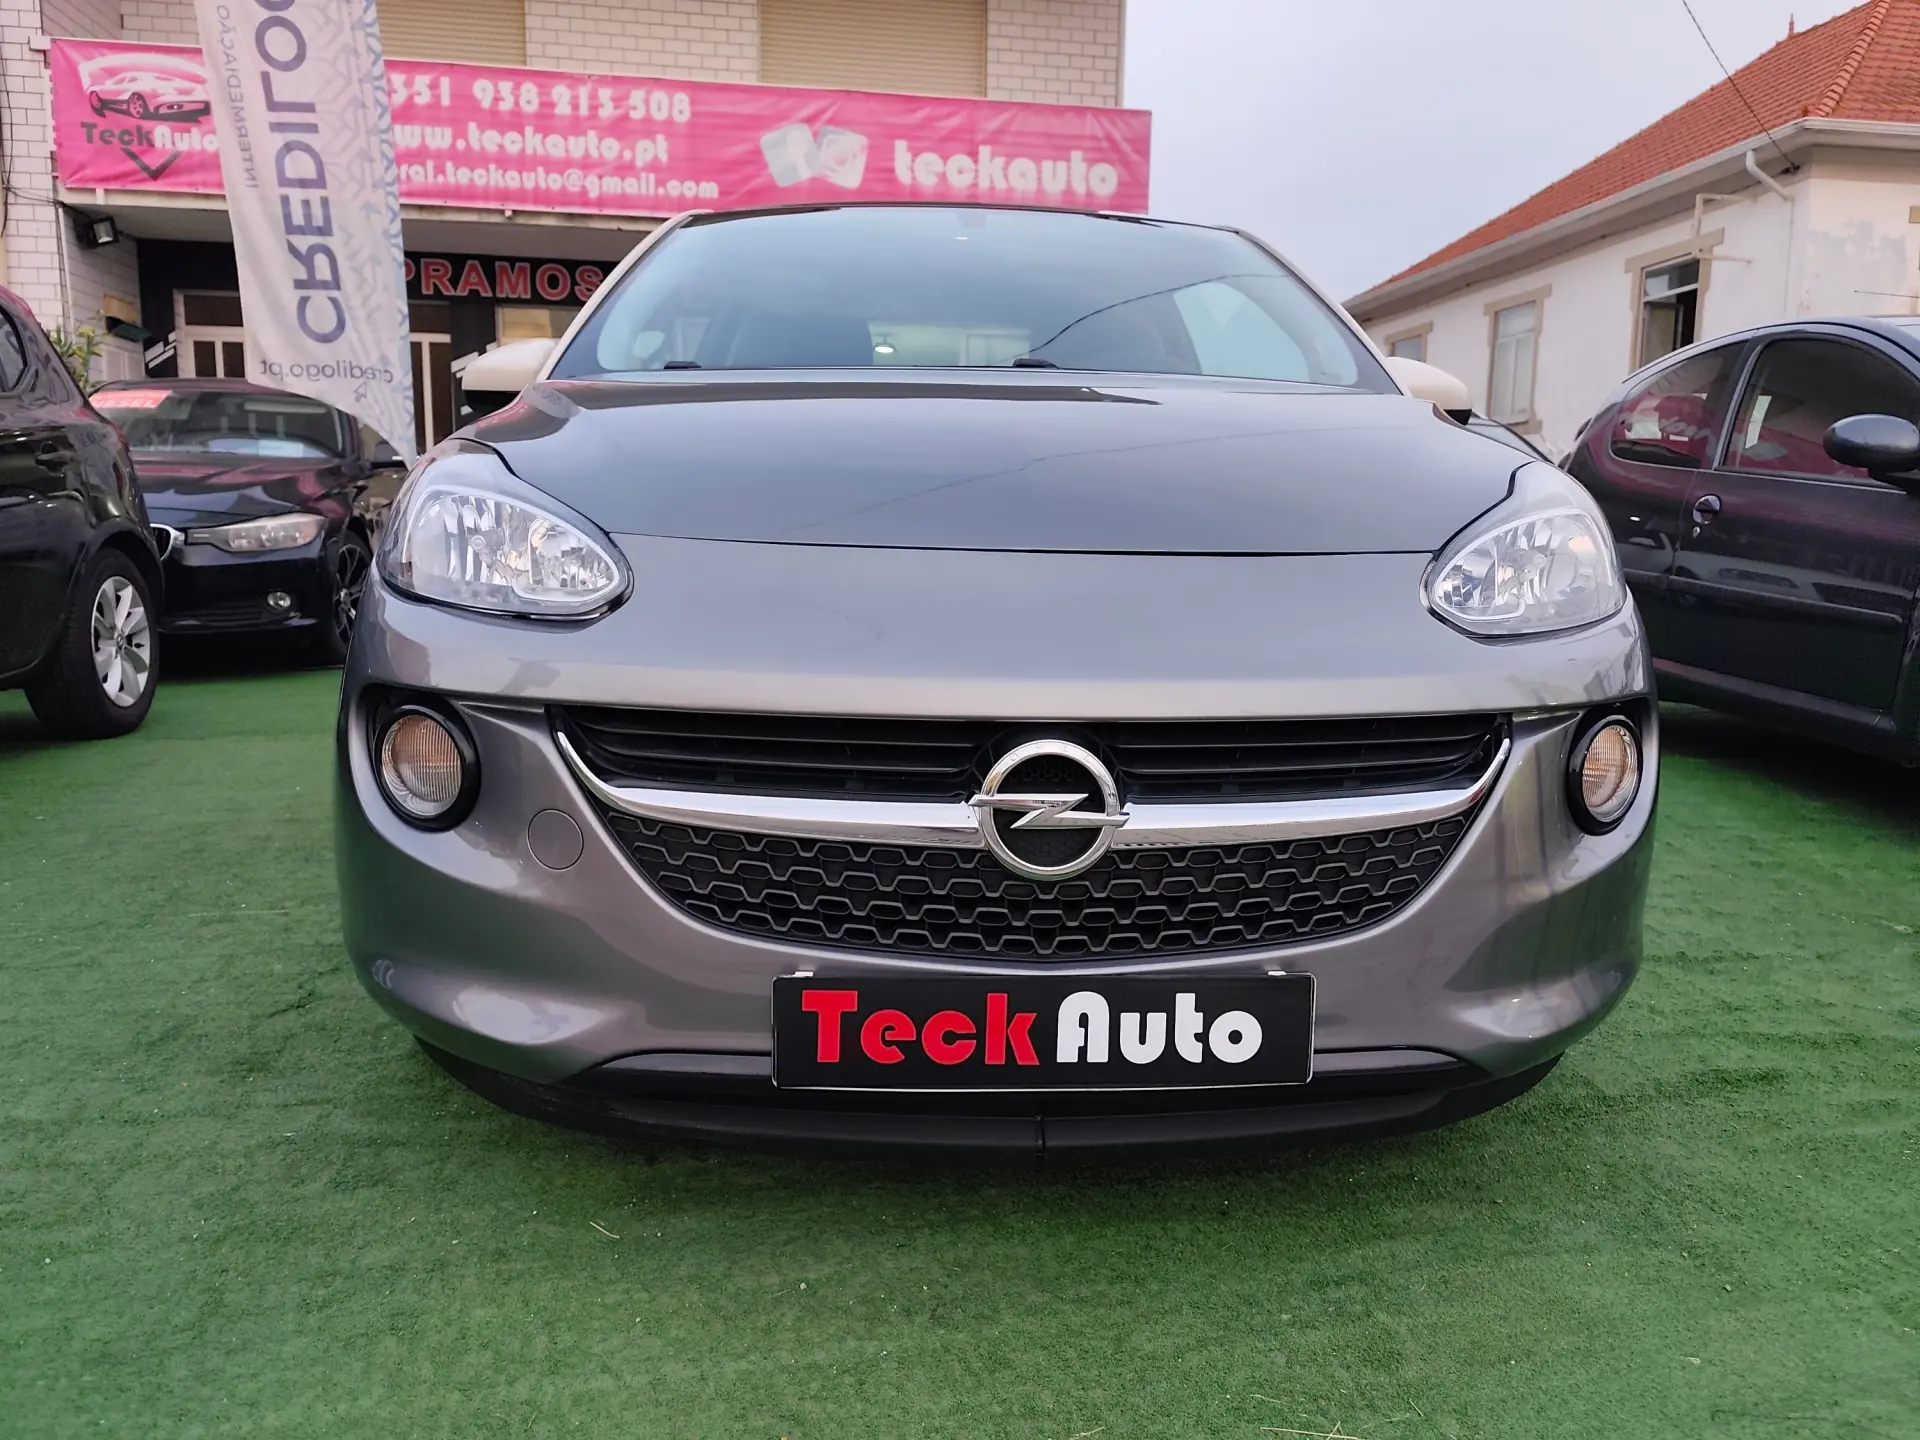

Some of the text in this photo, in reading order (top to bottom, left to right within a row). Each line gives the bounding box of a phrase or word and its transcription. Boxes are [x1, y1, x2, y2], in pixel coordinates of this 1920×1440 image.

[473, 79, 540, 112] 938
[552, 84, 614, 118] 213
[628, 90, 692, 124] 508
[397, 159, 719, 199] ral.teckauto@gmail.com
[894, 139, 1119, 197] teckauto
[802, 989, 1263, 1065] Teck Auto
